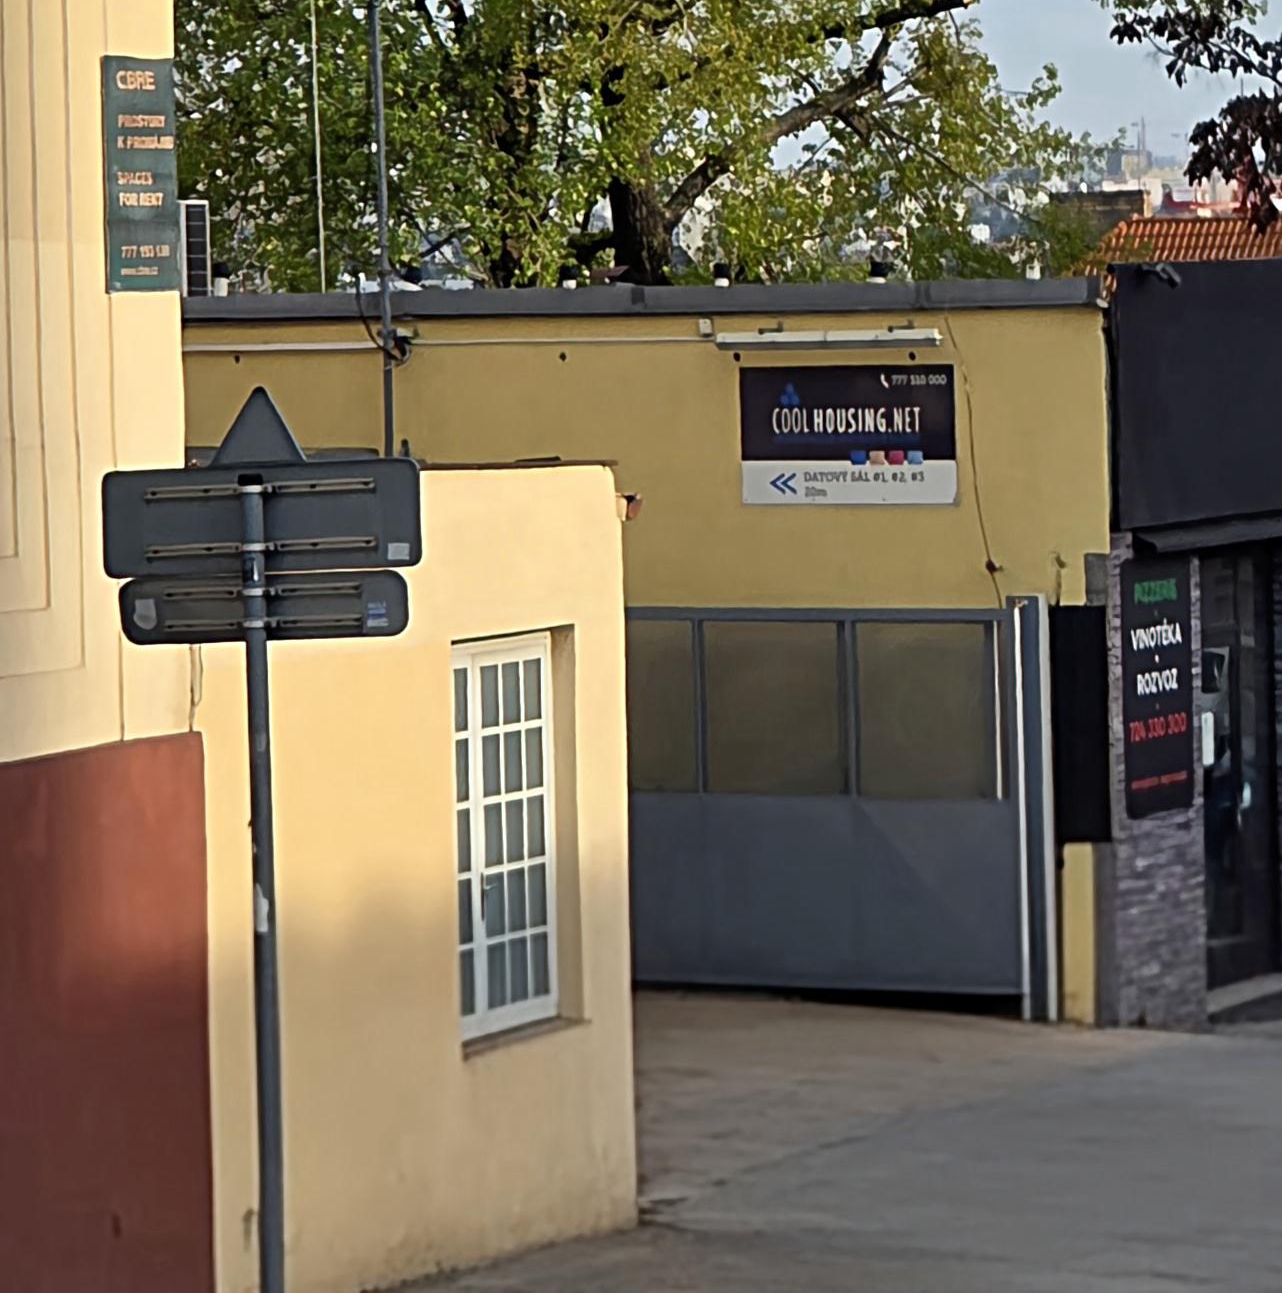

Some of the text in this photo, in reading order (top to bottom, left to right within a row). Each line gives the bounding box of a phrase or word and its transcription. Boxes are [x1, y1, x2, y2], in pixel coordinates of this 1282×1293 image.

[116, 70, 156, 90] CBRE
[119, 192, 138, 207] FOR
[891, 374, 908, 386] 777
[928, 374, 948, 385] 000
[1130, 618, 1183, 651] VINOTÉKA
[1137, 668, 1179, 696] ROZVOZ
